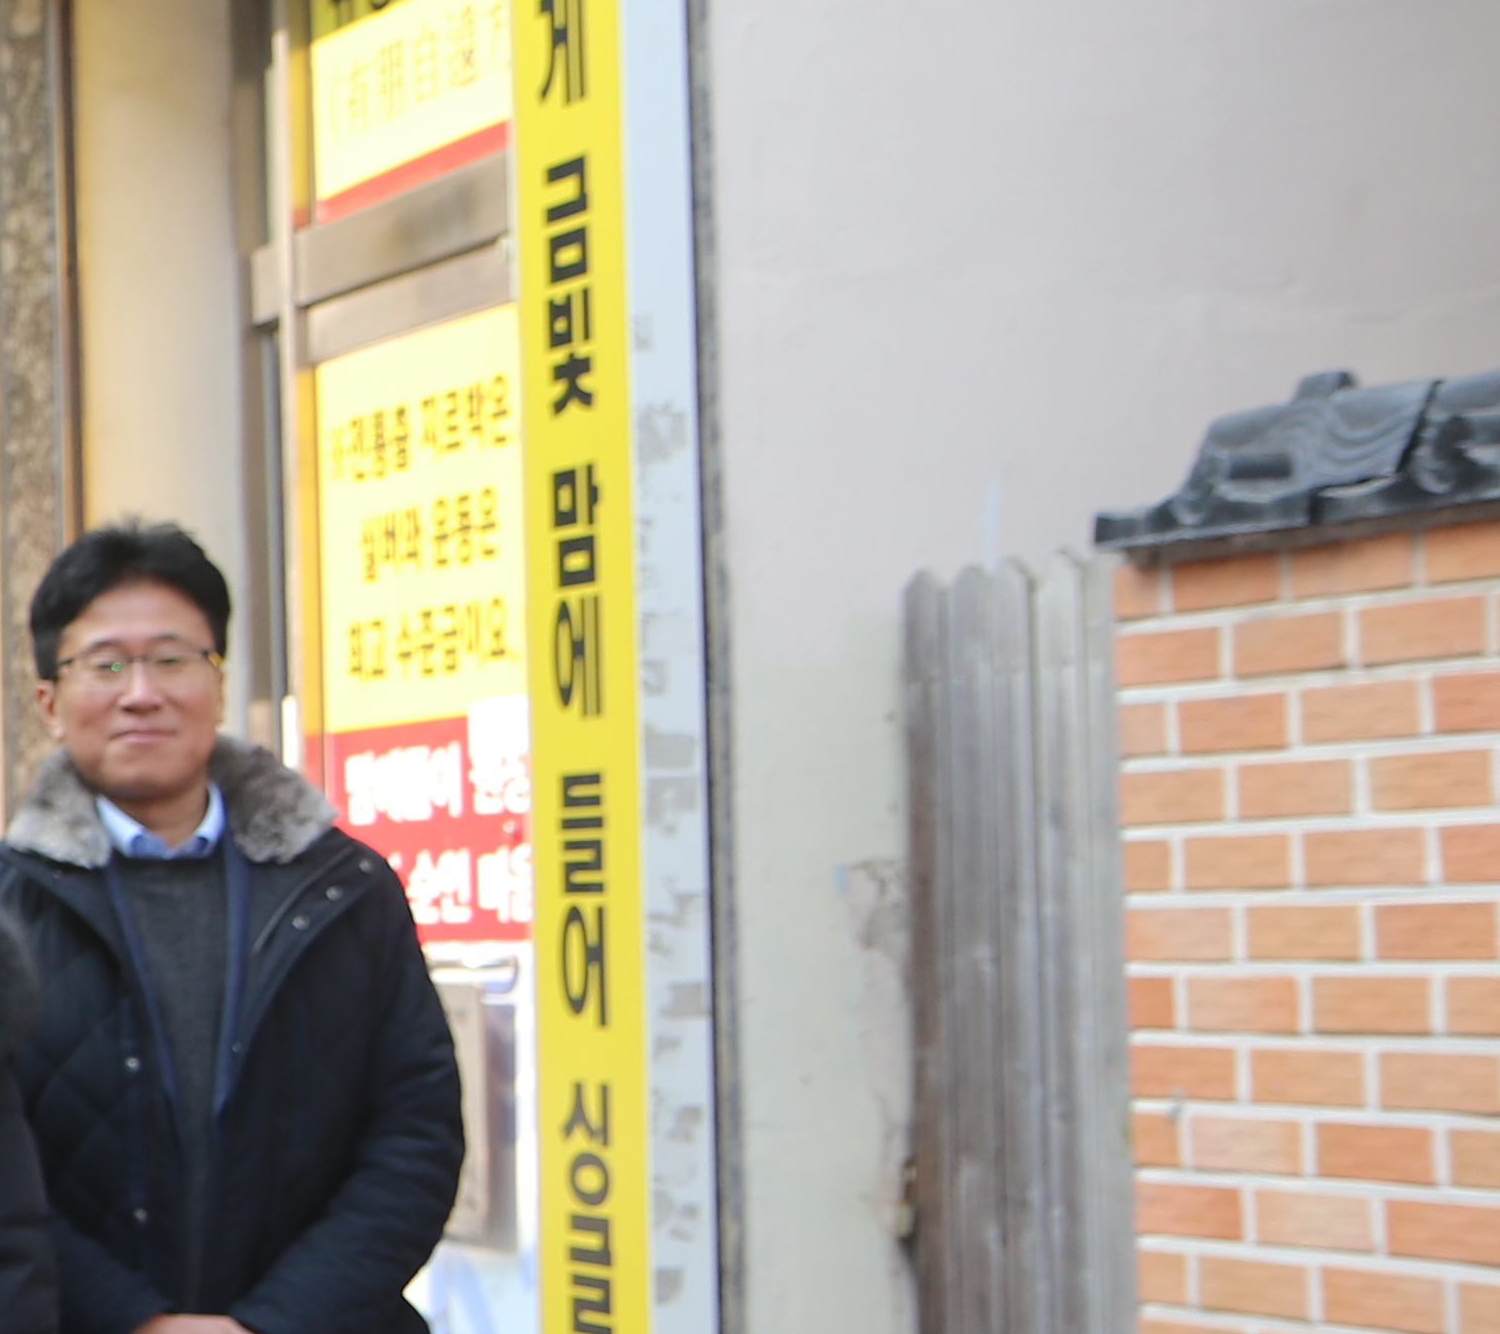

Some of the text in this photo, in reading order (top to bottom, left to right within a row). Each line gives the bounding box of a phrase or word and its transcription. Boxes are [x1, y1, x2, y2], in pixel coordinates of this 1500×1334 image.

[545, 152, 596, 419] 금빛
[551, 462, 603, 721] 맘에
[557, 770, 609, 1028] 들어
